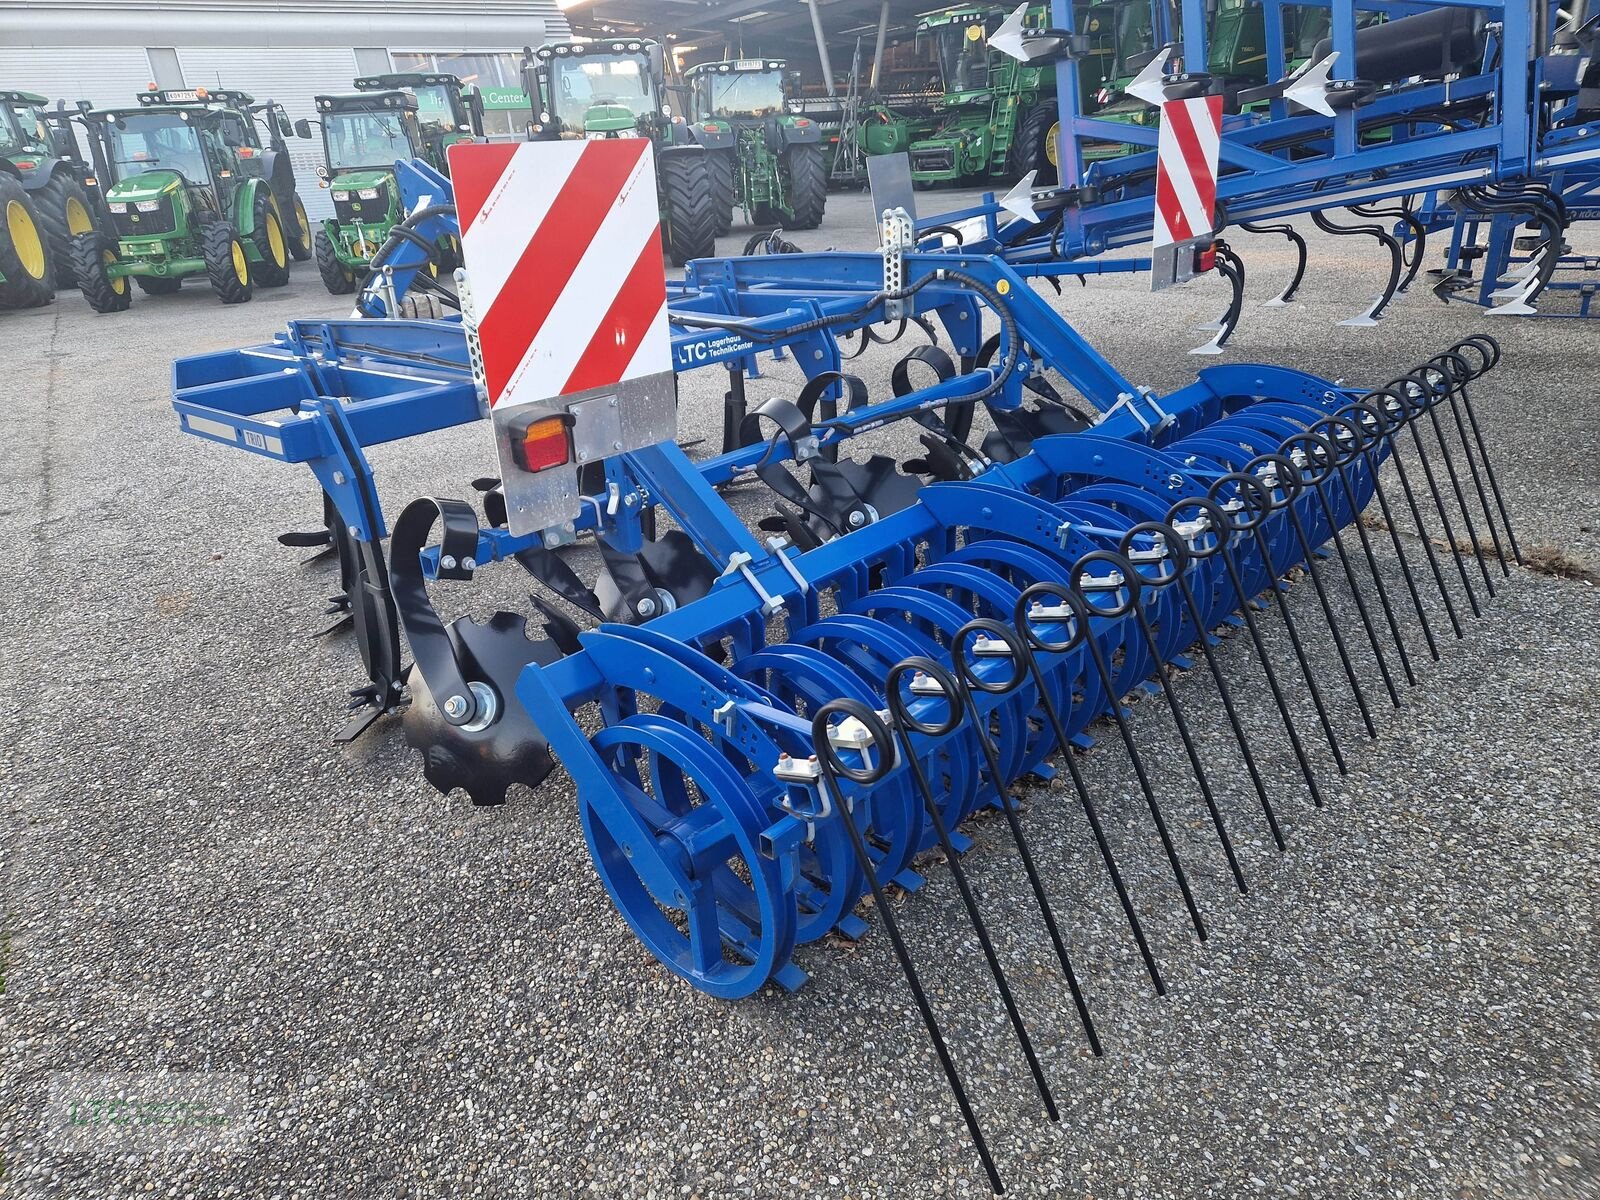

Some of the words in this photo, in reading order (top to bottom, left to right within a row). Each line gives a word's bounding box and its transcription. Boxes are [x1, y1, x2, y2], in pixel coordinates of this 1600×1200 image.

[489, 92, 524, 104] Center
[707, 335, 741, 349] Lagerhaus
[708, 341, 753, 357] TechnikCenter
[677, 342, 707, 364] LTC
[245, 431, 263, 448] TRIO
